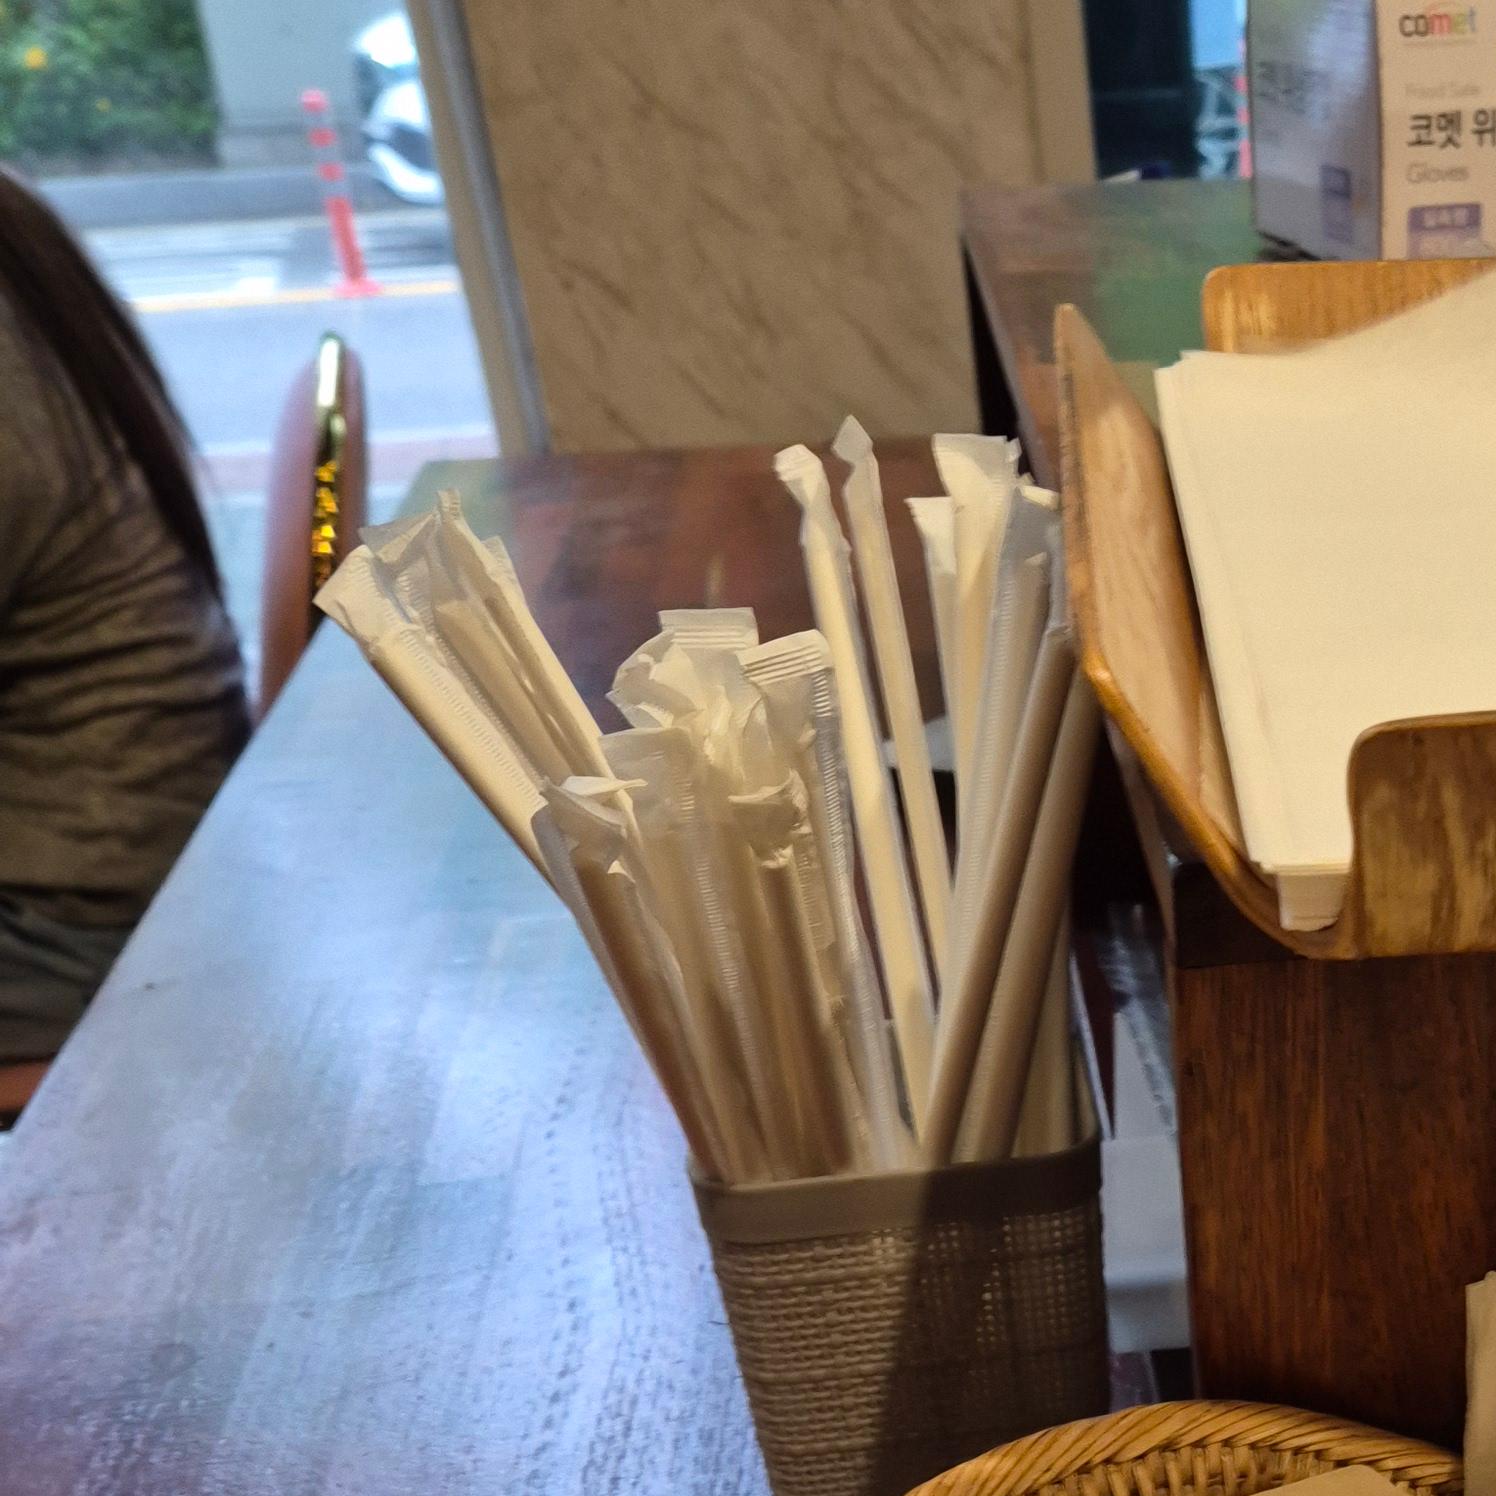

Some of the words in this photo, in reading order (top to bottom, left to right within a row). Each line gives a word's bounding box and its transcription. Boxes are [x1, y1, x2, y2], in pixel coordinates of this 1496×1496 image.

[1400, 6, 1477, 37] comet
[1407, 109, 1462, 149] 코멧
[1406, 163, 1469, 183] Gloves
